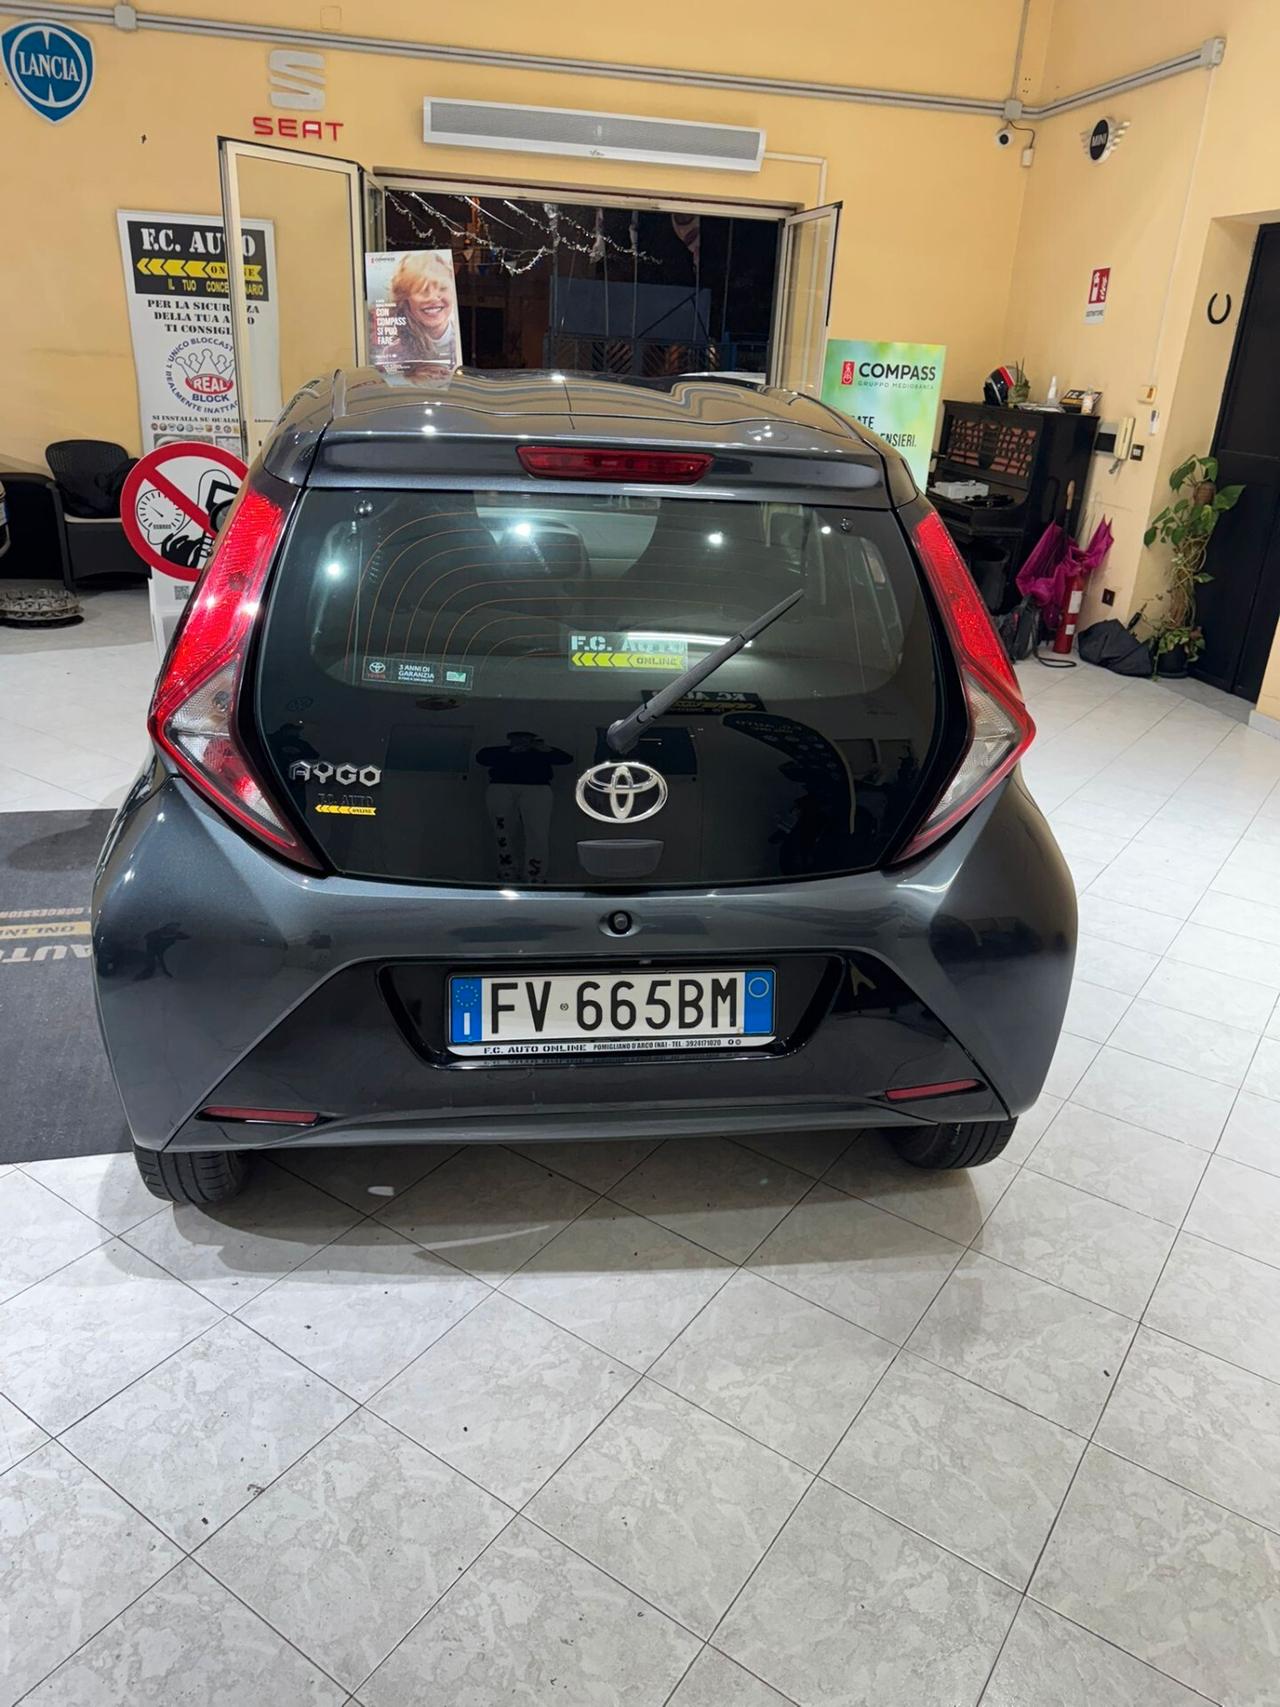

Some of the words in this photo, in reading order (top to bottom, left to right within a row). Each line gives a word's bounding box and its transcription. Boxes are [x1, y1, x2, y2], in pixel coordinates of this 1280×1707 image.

[19, 51, 80, 82] LANCIA
[252, 116, 344, 142] SEAT
[140, 228, 182, 252] F.C.
[189, 231, 256, 257] AUO
[168, 279, 175, 290] IL
[182, 280, 197, 291] TUO
[147, 299, 172, 309] PER
[175, 300, 190, 310] LA
[193, 301, 260, 314] SICURZA
[154, 311, 191, 321] DELLA
[195, 313, 219, 323] TUA
[222, 315, 255, 325] AO
[377, 317, 408, 326] COMPASS
[165, 323, 178, 332] TI
[181, 325, 233, 335] CONSIGL
[168, 341, 189, 362] UNICO
[190, 337, 234, 352] BLOCCAST
[859, 362, 936, 381] COMPASS
[193, 376, 228, 393] REAL
[857, 380, 889, 388] GRUPPO
[192, 393, 230, 403] BLOCK
[571, 635, 613, 651] F.C.
[636, 657, 678, 666] ONLINE
[398, 671, 434, 679] GARANZIA
[289, 760, 381, 787] AYGO
[0, 944, 92, 963] AUT
[491, 981, 551, 1033] FV
[576, 977, 738, 1031] 665BM
[464, 1012, 470, 1035] I
[543, 1044, 587, 1052] ONLINE
